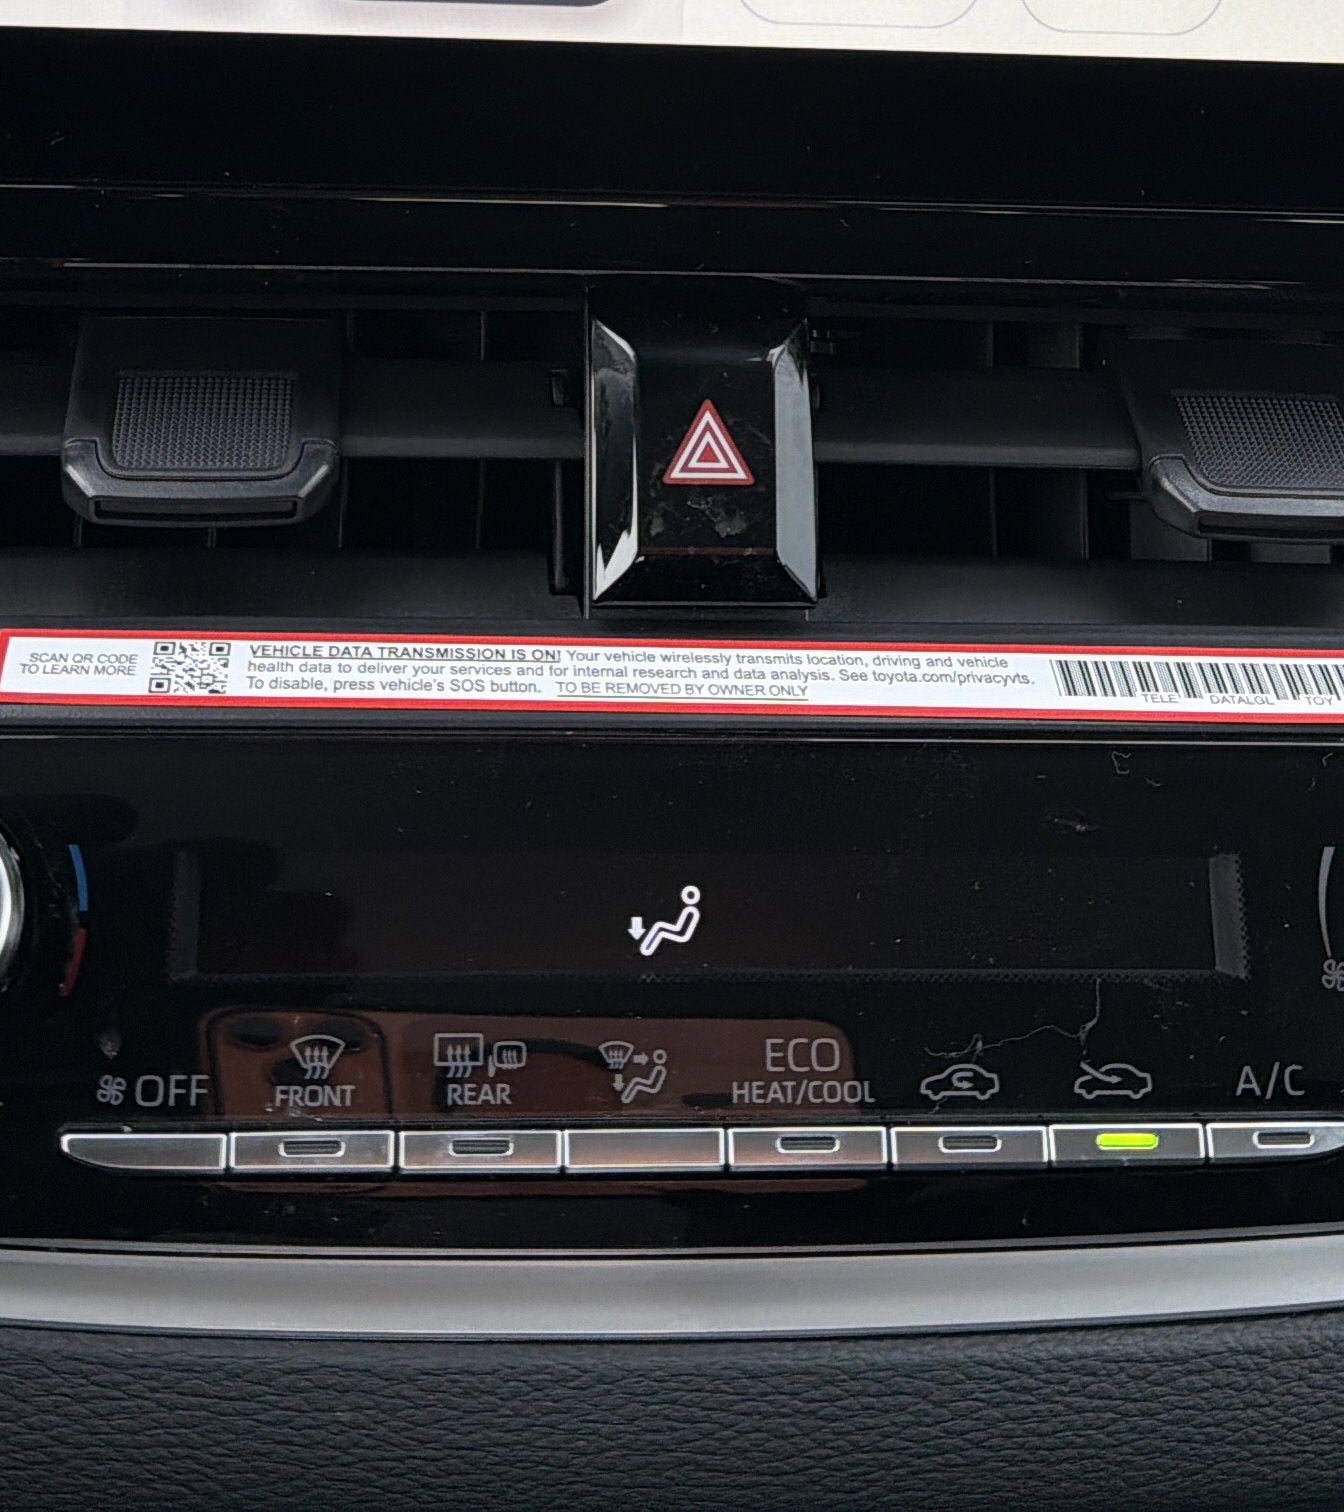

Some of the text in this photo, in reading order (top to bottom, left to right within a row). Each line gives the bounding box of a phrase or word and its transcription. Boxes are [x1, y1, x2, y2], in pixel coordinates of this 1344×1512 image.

[28, 652, 139, 664] SCAN QR CODE
[249, 644, 1009, 669] VEHICLE DATA TRANSMISSION IS ON! Your vehicle wirelessly transmits location, driving and vehicle
[19, 663, 138, 676] TO LEARN MORE
[247, 660, 294, 673] health
[299, 661, 332, 673] data
[337, 662, 352, 673] to
[357, 662, 408, 675] deliver
[412, 664, 446, 677] your
[449, 664, 512, 676] services
[516, 664, 544, 677] and
[549, 664, 569, 677] for
[573, 665, 629, 678] internal
[632, 666, 698, 679] research
[702, 667, 730, 680] and
[734, 667, 766, 680] data
[770, 668, 836, 683] analysis.
[839, 668, 869, 682] See
[246, 675, 809, 697] To disable, press vehicle's SOS button. TO BE REMOVED BY OWNER ONLY
[1141, 692, 1179, 704] TELE
[1305, 695, 1334, 706] TOY
[764, 1037, 841, 1073] ECO
[135, 1074, 211, 1108] OFF
[731, 1079, 875, 1106] HEAT/COOL
[1236, 1064, 1305, 1099] A/C
[274, 1084, 356, 1107] FRONT
[446, 1083, 511, 1106] REAR
